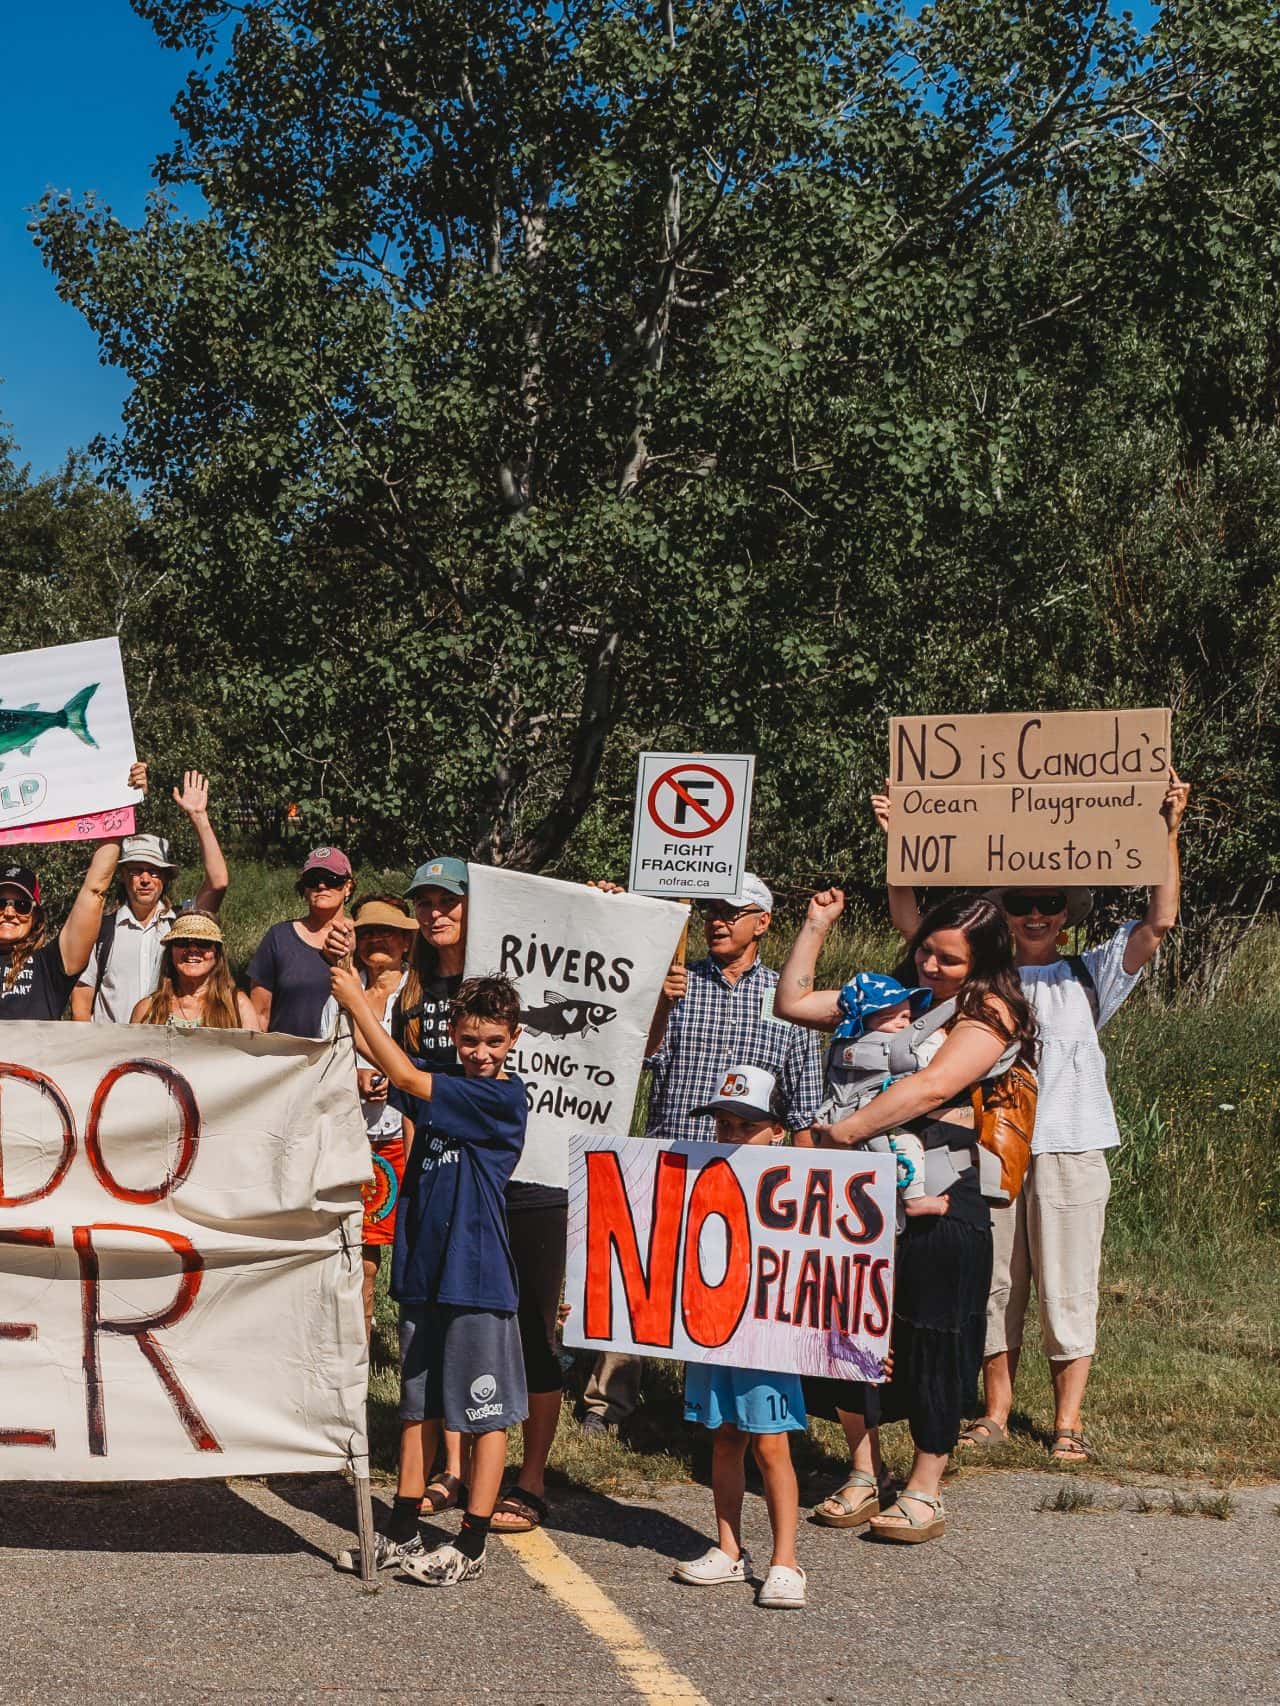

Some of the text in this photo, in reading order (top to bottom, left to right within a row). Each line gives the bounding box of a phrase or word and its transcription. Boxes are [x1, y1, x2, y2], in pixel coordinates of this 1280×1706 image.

[897, 717, 1167, 782] NS is Canada's
[903, 785, 1142, 824] Ocean Playground.
[641, 859, 733, 877] FRACKING!
[663, 844, 714, 857] FIGHT
[900, 834, 1142, 873] NOT Houston's
[659, 877, 710, 887] nofrac.ca
[503, 1048, 614, 1086] ELONG TO
[584, 1150, 884, 1349] NO GAS
[753, 1245, 889, 1337] PLANTS
[766, 1393, 788, 1421] 10
